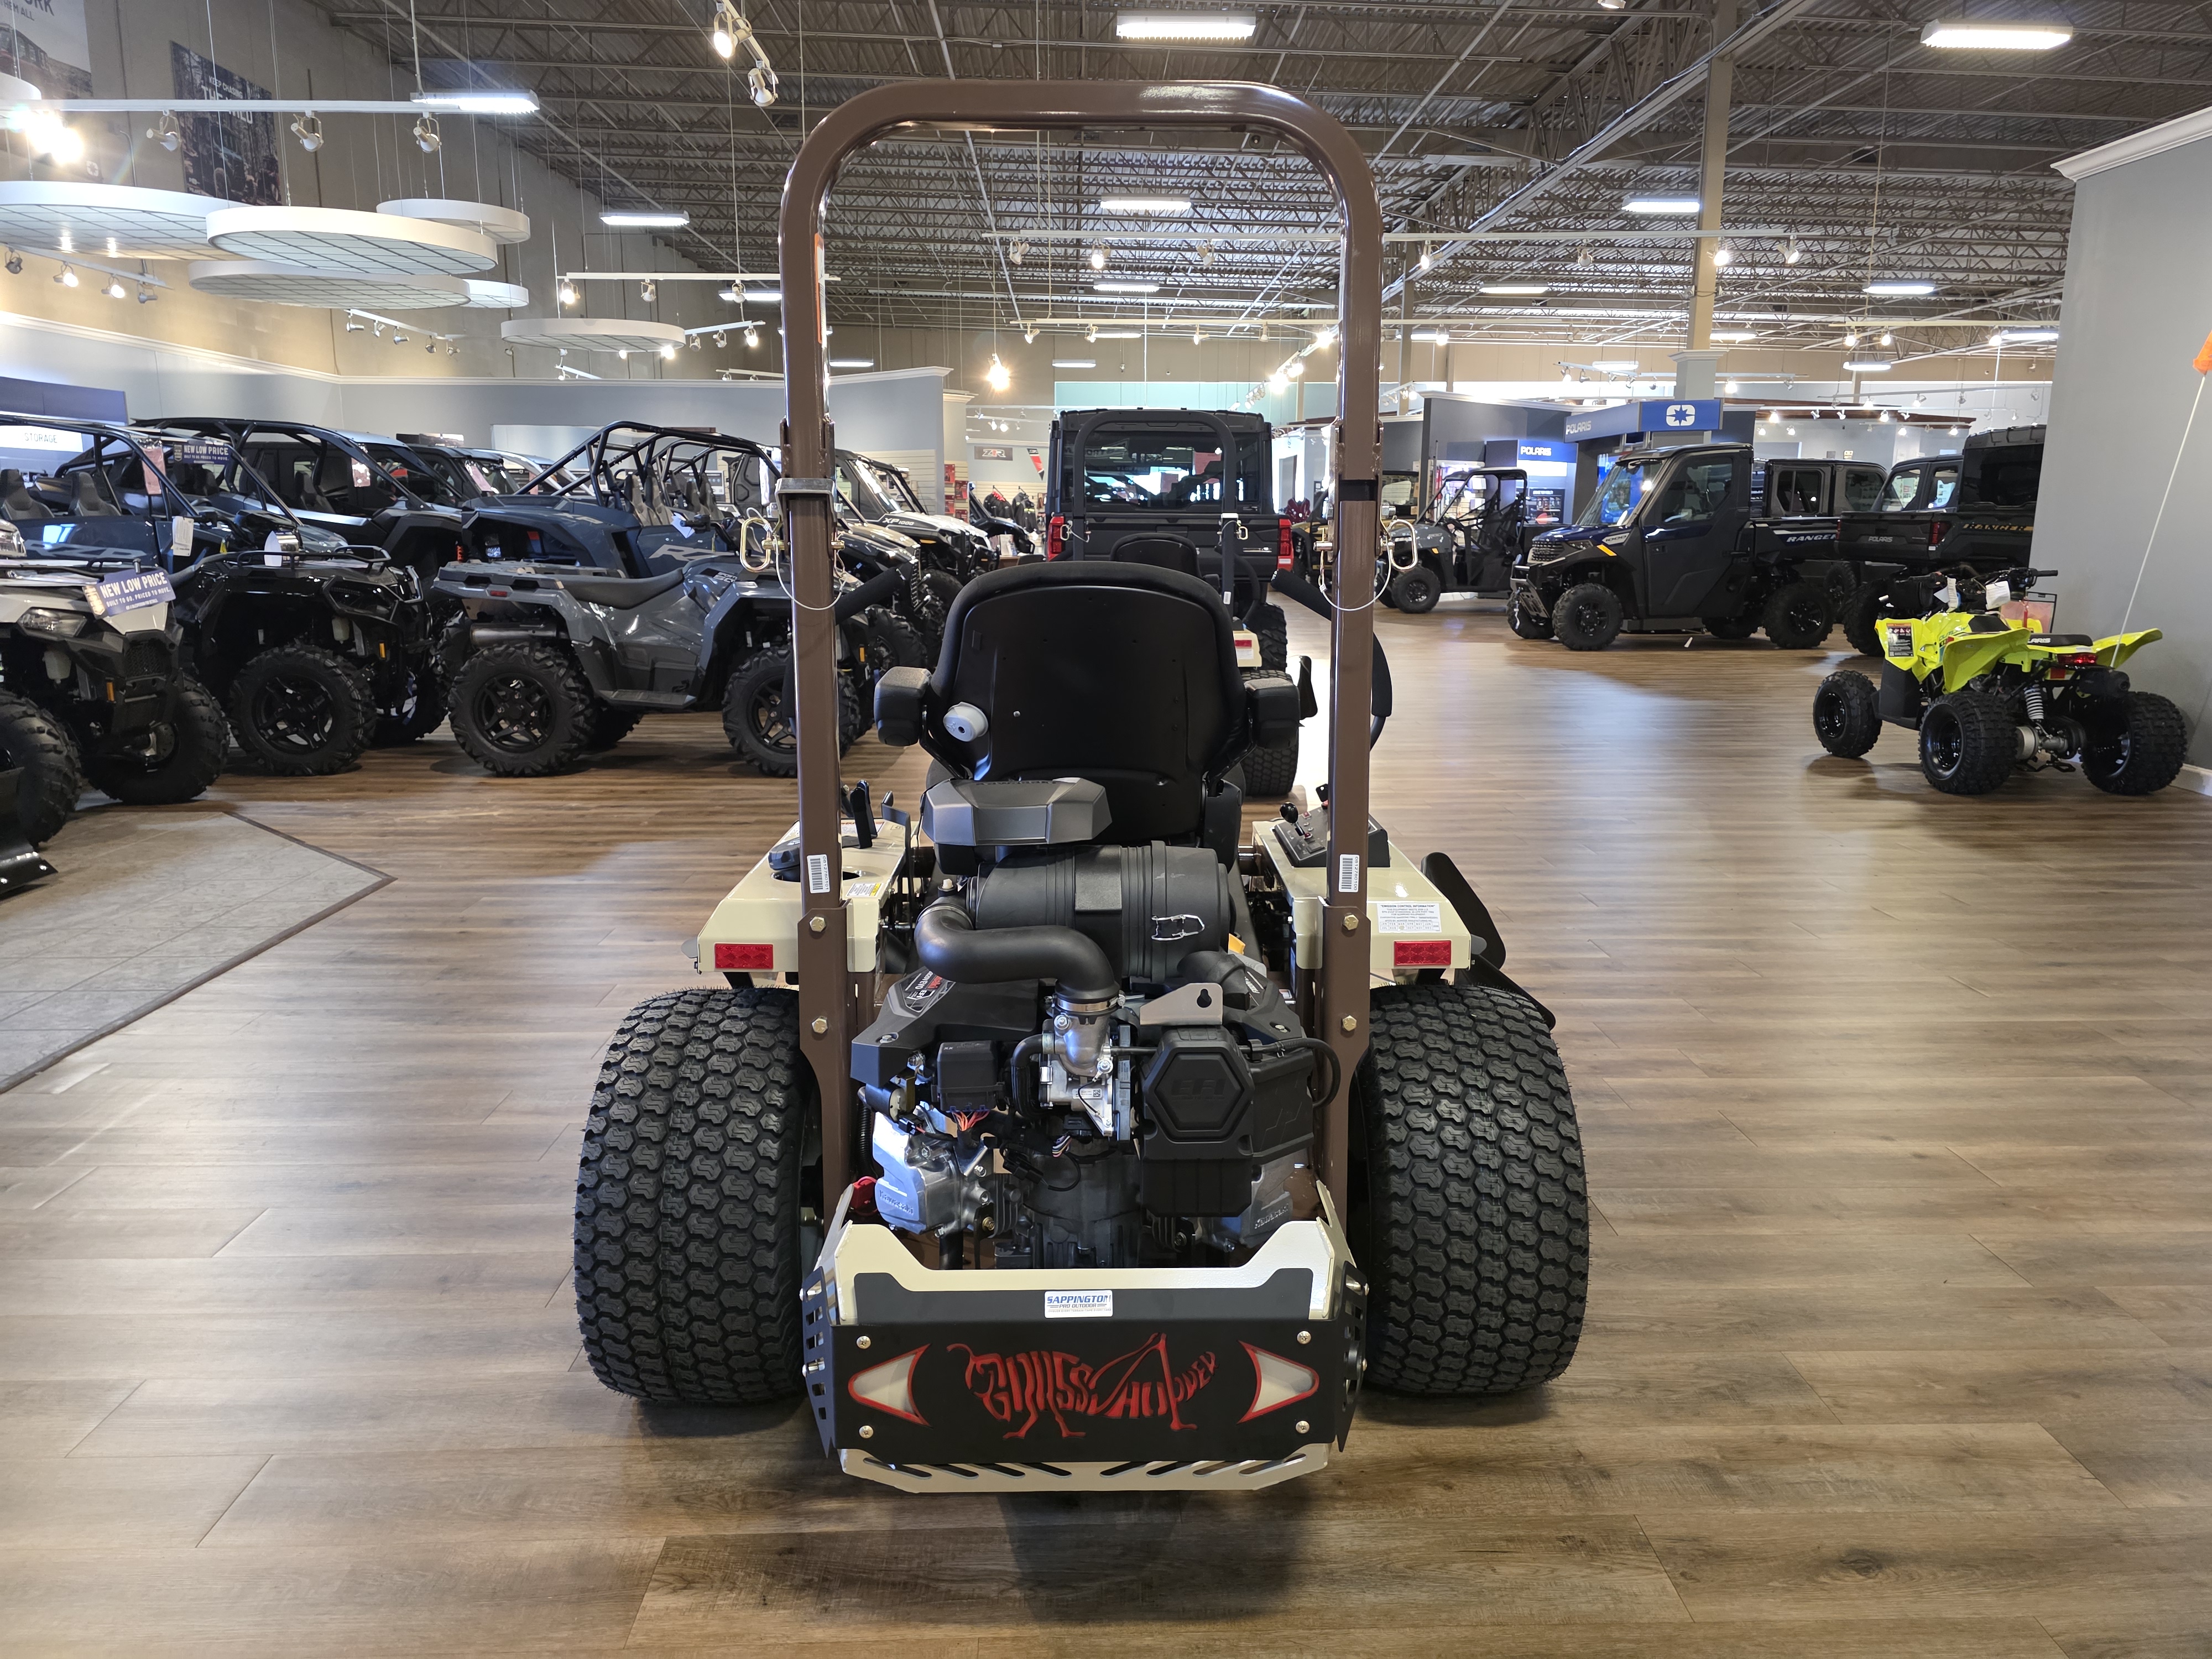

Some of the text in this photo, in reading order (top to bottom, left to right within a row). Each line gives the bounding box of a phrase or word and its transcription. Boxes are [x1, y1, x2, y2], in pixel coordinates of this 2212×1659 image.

[21, 7, 34, 21] ALL
[209, 75, 243, 99] KEEP CHASING
[1566, 420, 1592, 435] POLARIS
[25, 432, 58, 443] STORAGE
[184, 445, 195, 453] NEW
[196, 445, 207, 454] LOW
[208, 446, 229, 455] PRICE
[1521, 446, 1551, 456] POLARIS
[100, 572, 168, 598] NEW LOW PRICE
[106, 599, 118, 608] BUILT
[135, 592, 151, 600] PRICED
[915, 980, 928, 989] EVO
[1171, 1078, 1226, 1097] EFI
